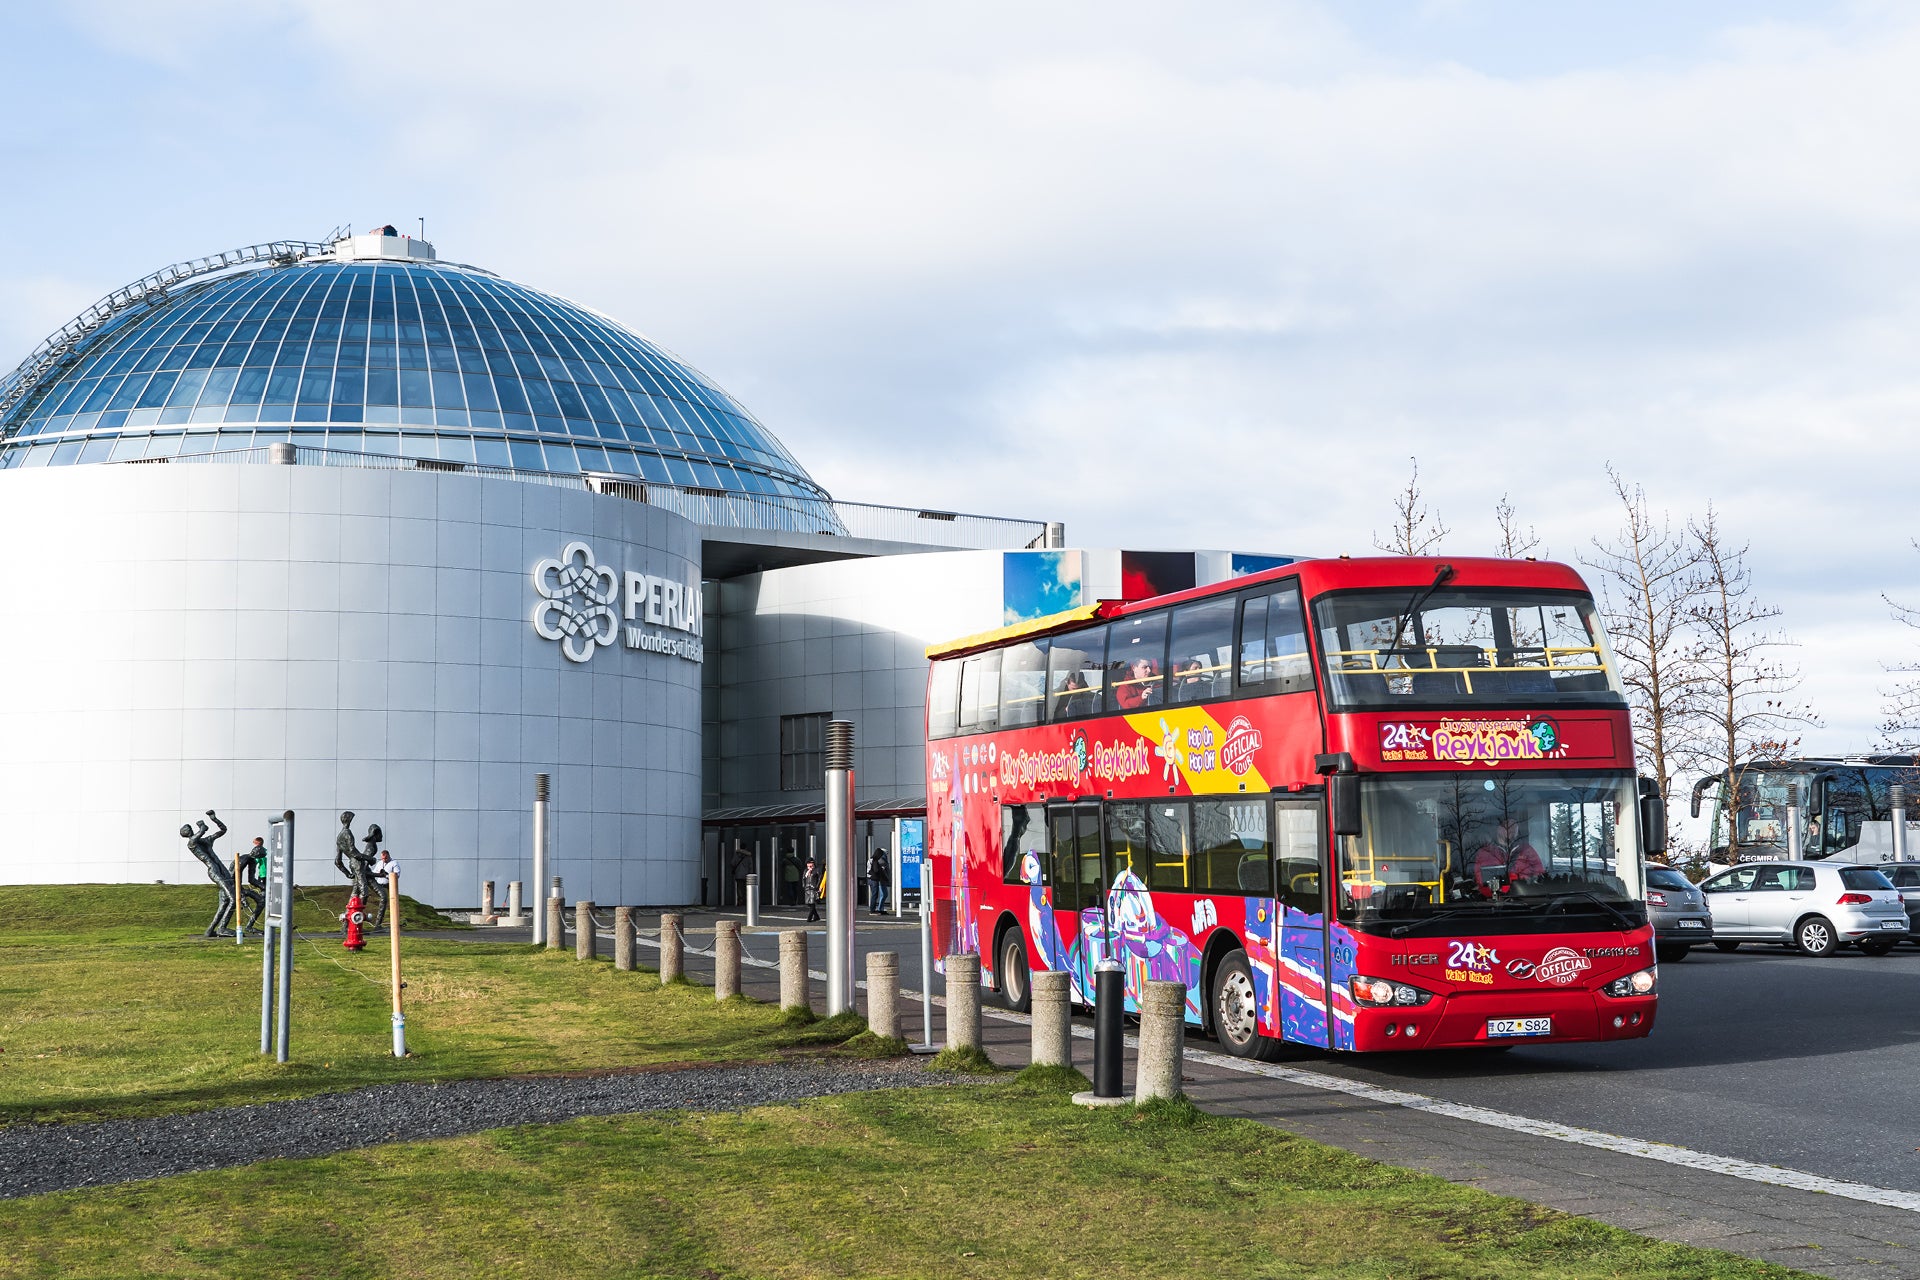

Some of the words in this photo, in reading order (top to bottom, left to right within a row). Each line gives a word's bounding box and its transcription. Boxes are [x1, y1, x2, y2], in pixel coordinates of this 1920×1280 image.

[624, 570, 702, 637] PERLAN
[625, 627, 677, 655] Wonders
[1188, 728, 1202, 750] Hop
[1203, 725, 1213, 747] On
[1224, 733, 1259, 764] OFFICIAL
[1382, 724, 1409, 748] 24
[1432, 728, 1543, 766] Reykjavik
[1094, 737, 1150, 782] Reykjavik
[1189, 752, 1203, 774] Hop
[1204, 749, 1215, 771] Off
[1235, 755, 1252, 773] TOUR
[1391, 954, 1439, 965] HIGER
[1448, 941, 1476, 968] 24
[1445, 969, 1467, 981] Valid
[1541, 959, 1588, 978] OFFICIAL
[1556, 972, 1577, 983] TOUR
[1525, 1020, 1548, 1031] S82
